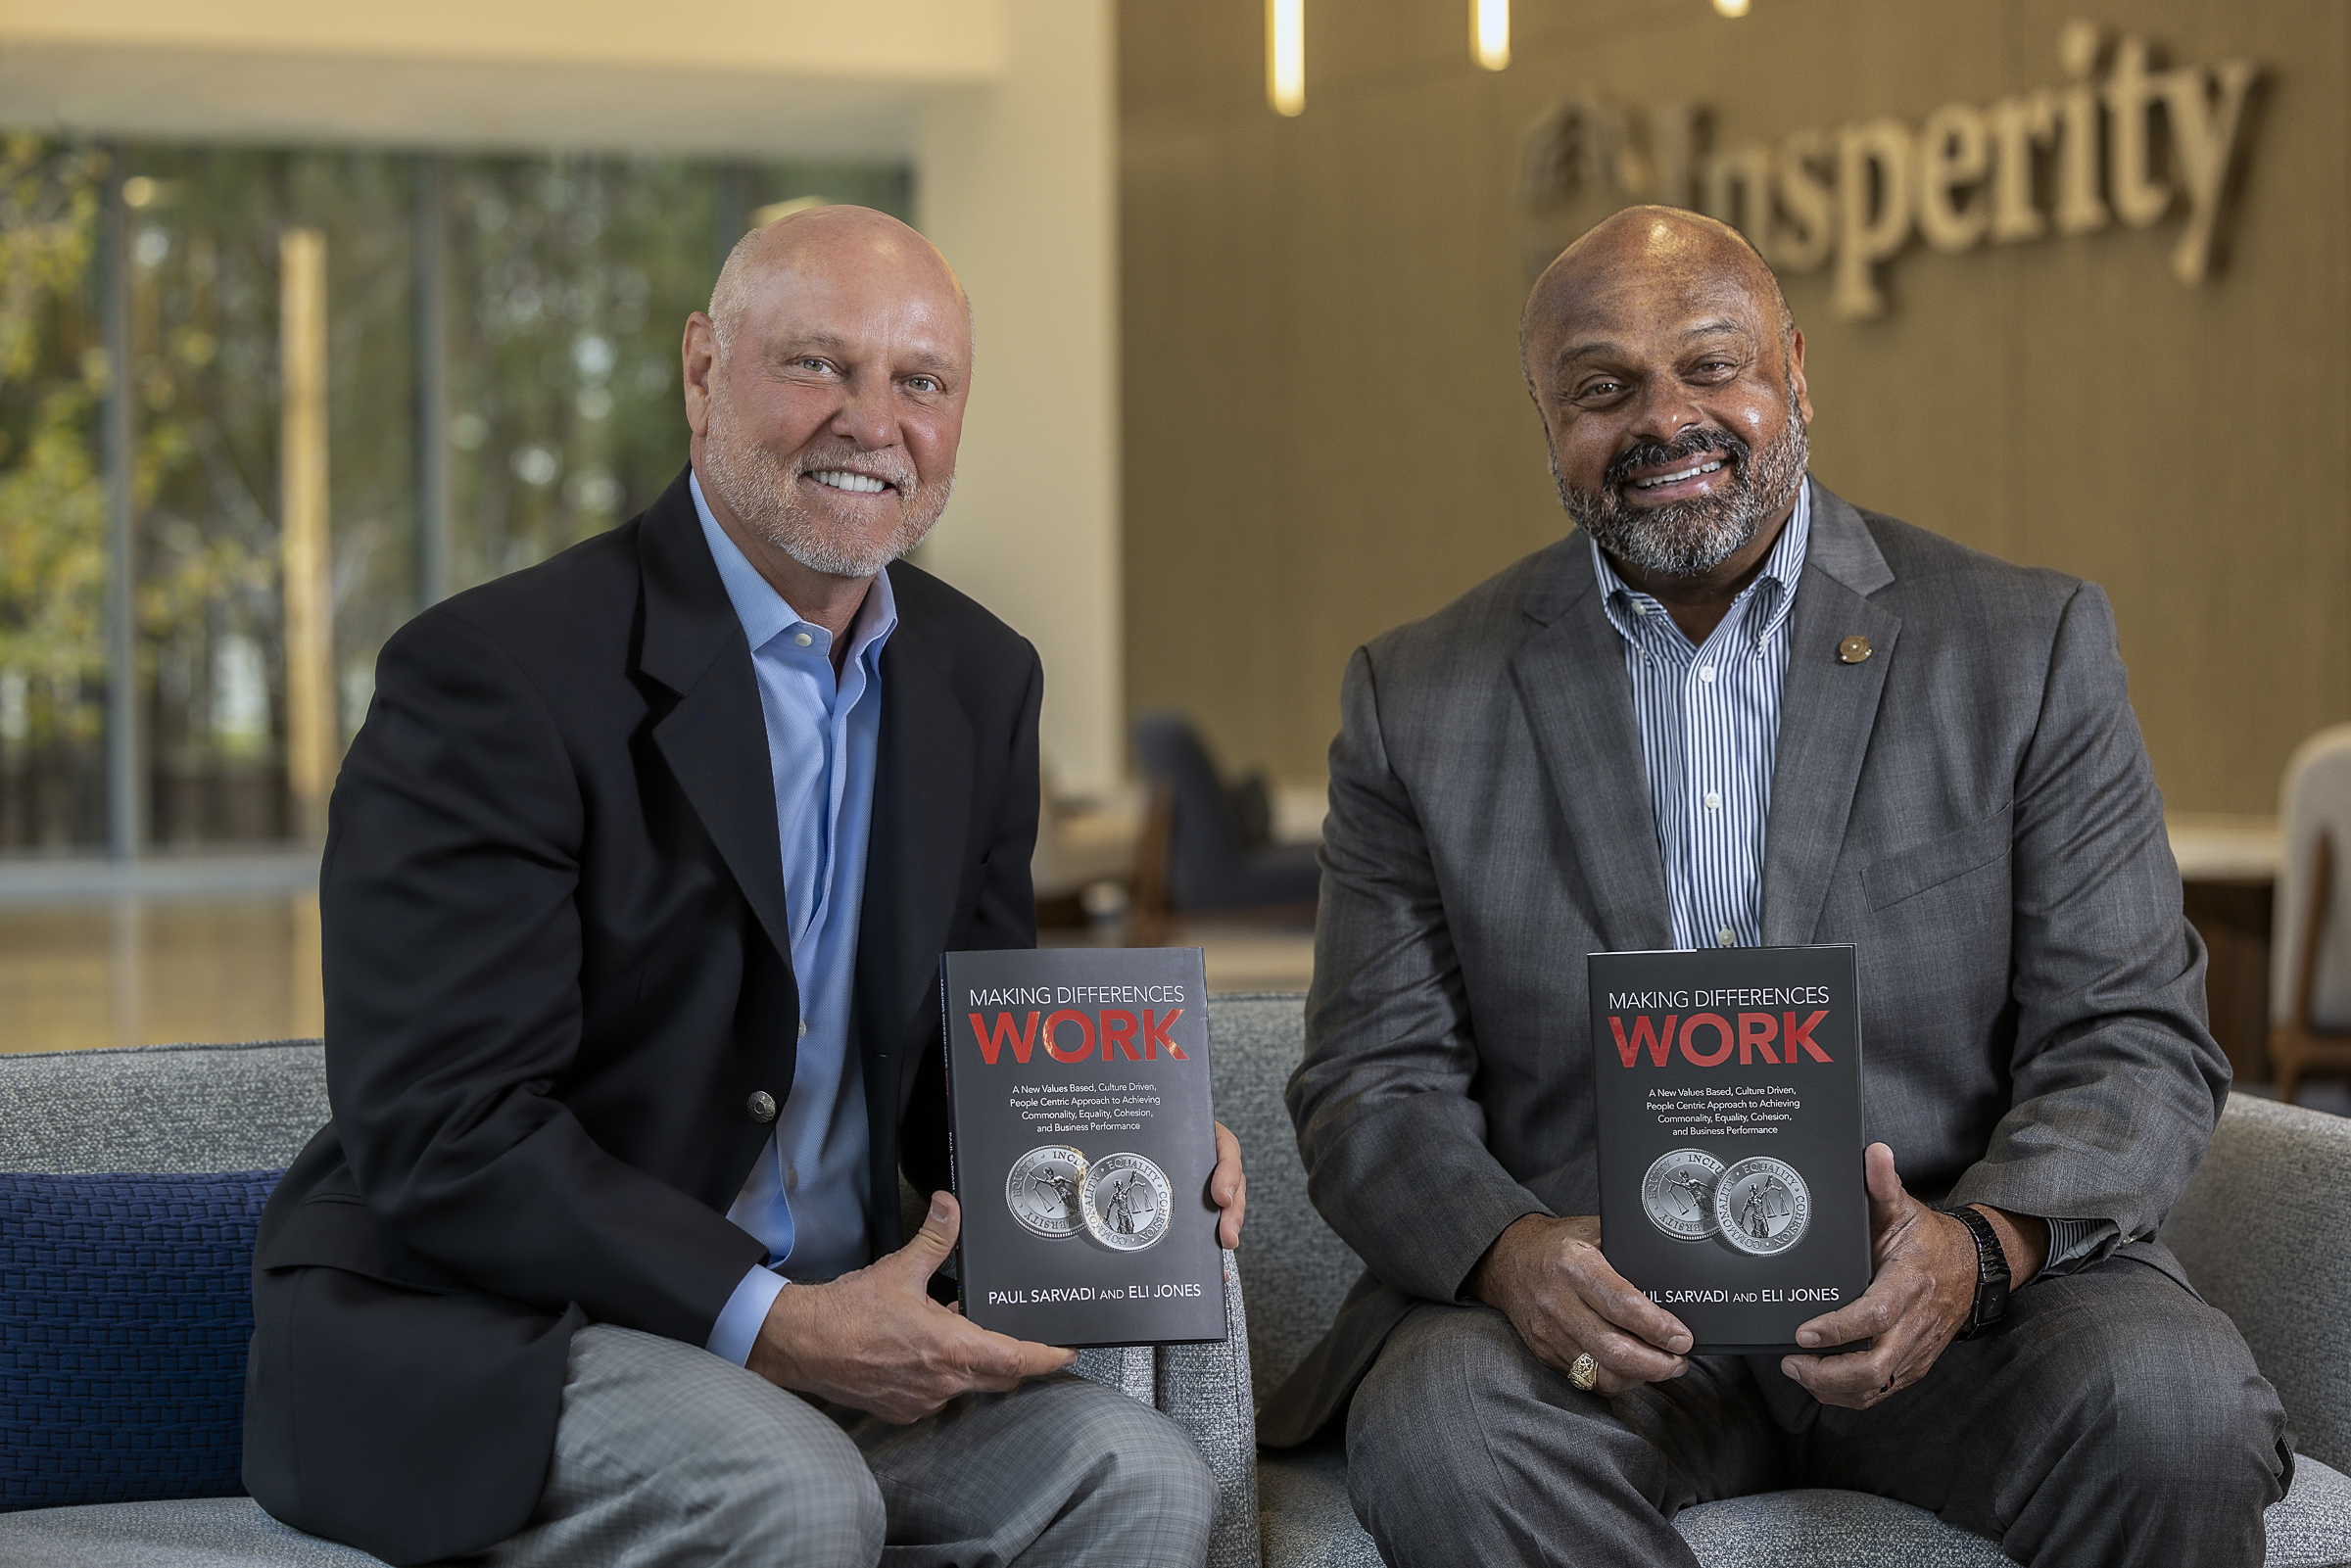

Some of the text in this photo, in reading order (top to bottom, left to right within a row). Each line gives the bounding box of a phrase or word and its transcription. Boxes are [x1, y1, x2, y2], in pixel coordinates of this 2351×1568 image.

[971, 985, 1184, 1006] MAKING DIFFERENCES
[1609, 986, 1829, 1009] MAKING DIFFERENCES
[969, 1009, 1189, 1065] WORK
[1608, 1011, 1834, 1068] WORK
[1069, 1083, 1097, 1092] Based,
[1705, 1087, 1734, 1096] Based,
[1009, 1098, 1039, 1109] People
[1070, 1096, 1111, 1107] Approach
[1122, 1095, 1161, 1105] Achieving
[1646, 1102, 1675, 1112] People
[1706, 1100, 1748, 1111] Approach
[1758, 1099, 1800, 1109] Achieving
[1021, 1110, 1078, 1120] Commonality,
[1079, 1110, 1113, 1119] Equality,
[1657, 1114, 1713, 1123] Commonality,
[1714, 1113, 1750, 1123] Equality,
[1036, 1123, 1053, 1132] and
[1089, 1121, 1141, 1130] Performance
[1726, 1125, 1779, 1134] Performance
[1107, 1158, 1160, 1182] EQUALITY
[1742, 1163, 1798, 1187] EQUALITY
[1718, 1177, 1762, 1250] COMMONALITY
[989, 1284, 1202, 1305] PAUL SARVADI AND ELI JONES
[1665, 1290, 1729, 1303] SARVADI
[1732, 1293, 1758, 1302] AND
[1761, 1290, 1784, 1302] ELI
[1788, 1288, 1839, 1302] JONES
